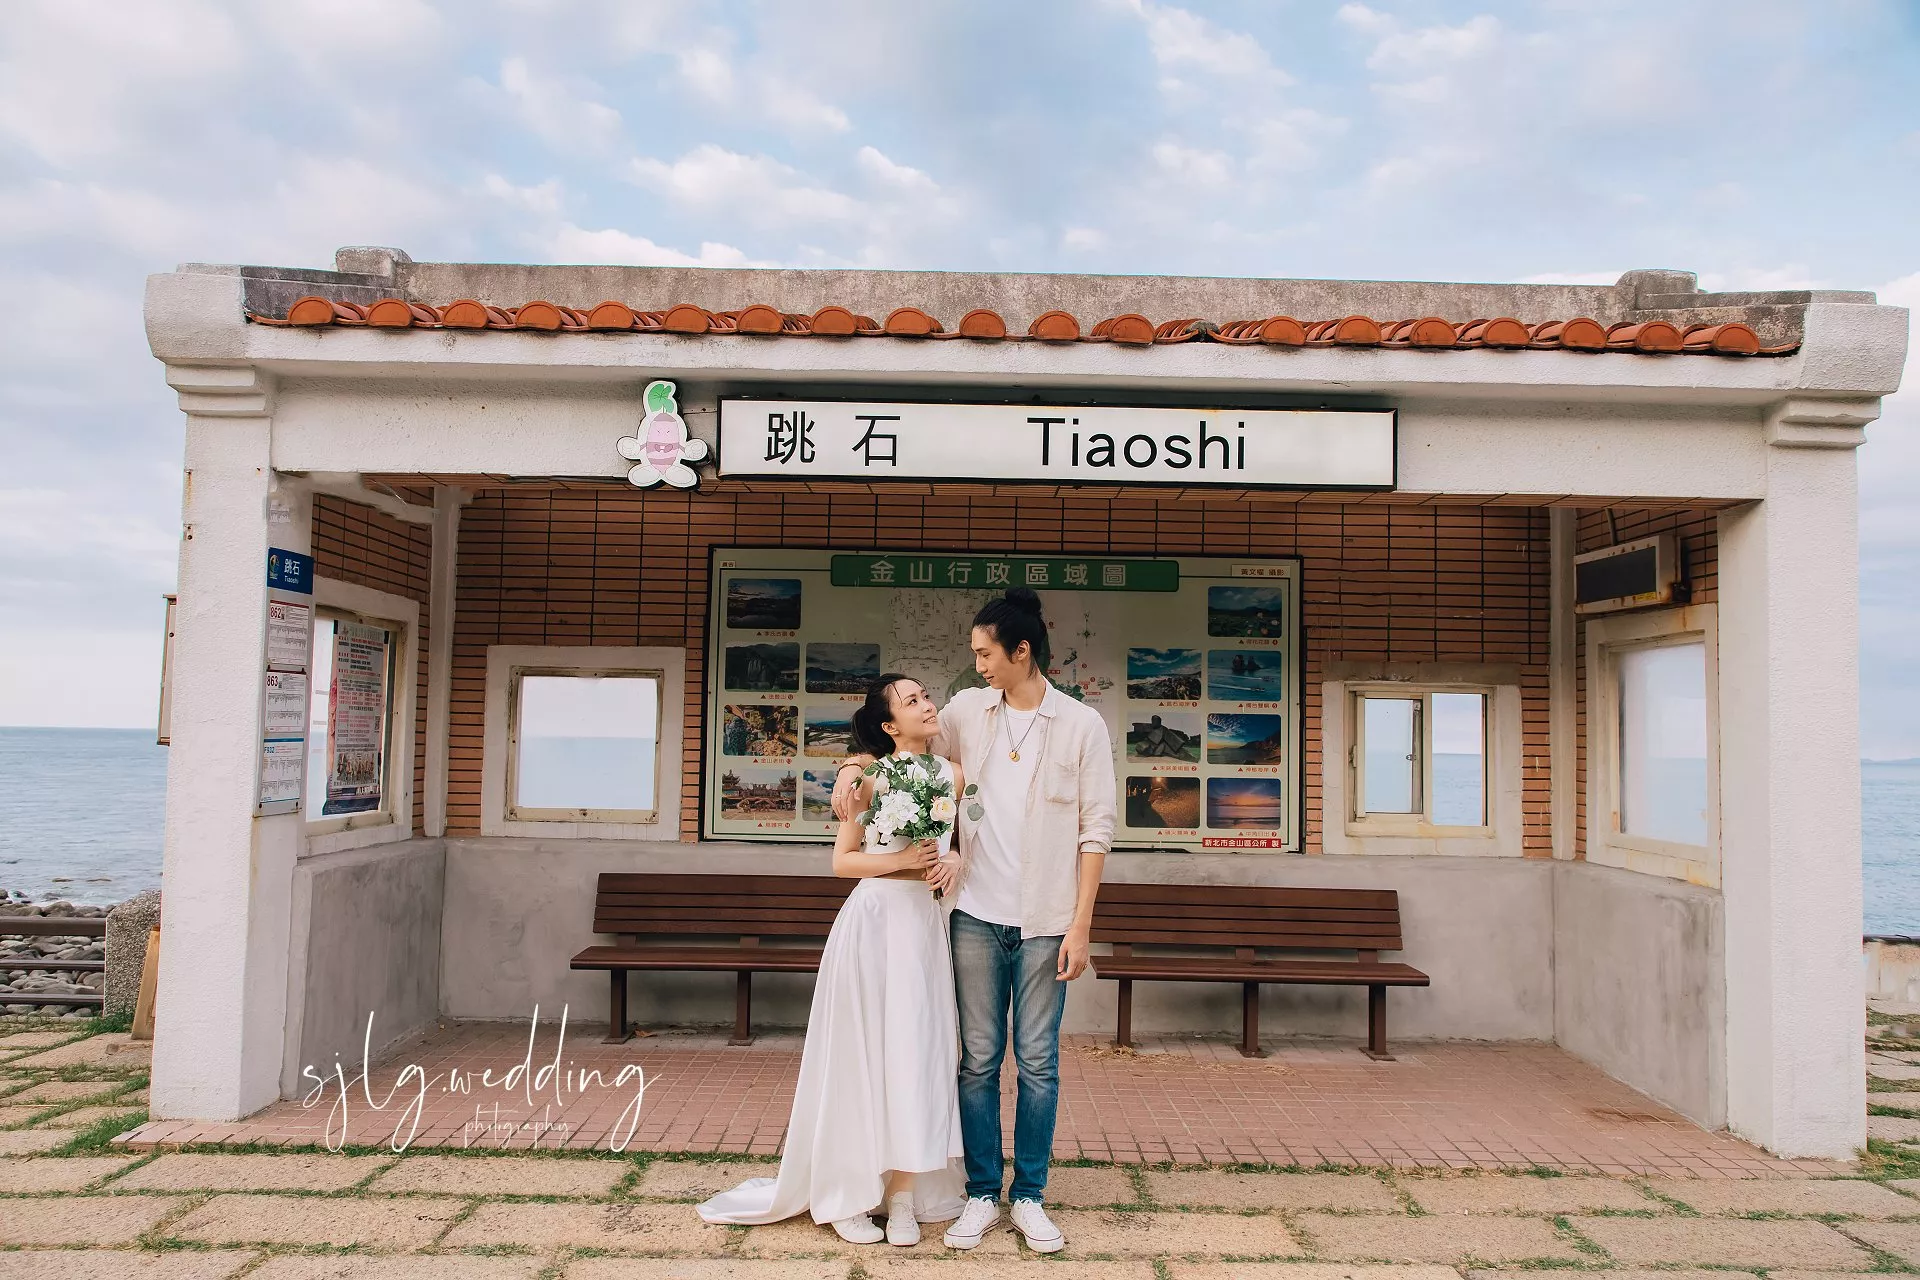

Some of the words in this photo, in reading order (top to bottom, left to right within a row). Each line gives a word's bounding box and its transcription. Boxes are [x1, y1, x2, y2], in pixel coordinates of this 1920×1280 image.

[763, 411, 901, 467] 跳石
[1026, 416, 1246, 470] Tiaoshi
[284, 558, 301, 576] 跳石
[869, 559, 1127, 587] 金山行政區域圖
[270, 606, 282, 619] 862
[266, 675, 279, 687] 863
[1204, 839, 1268, 847] 新北市金山區公所
